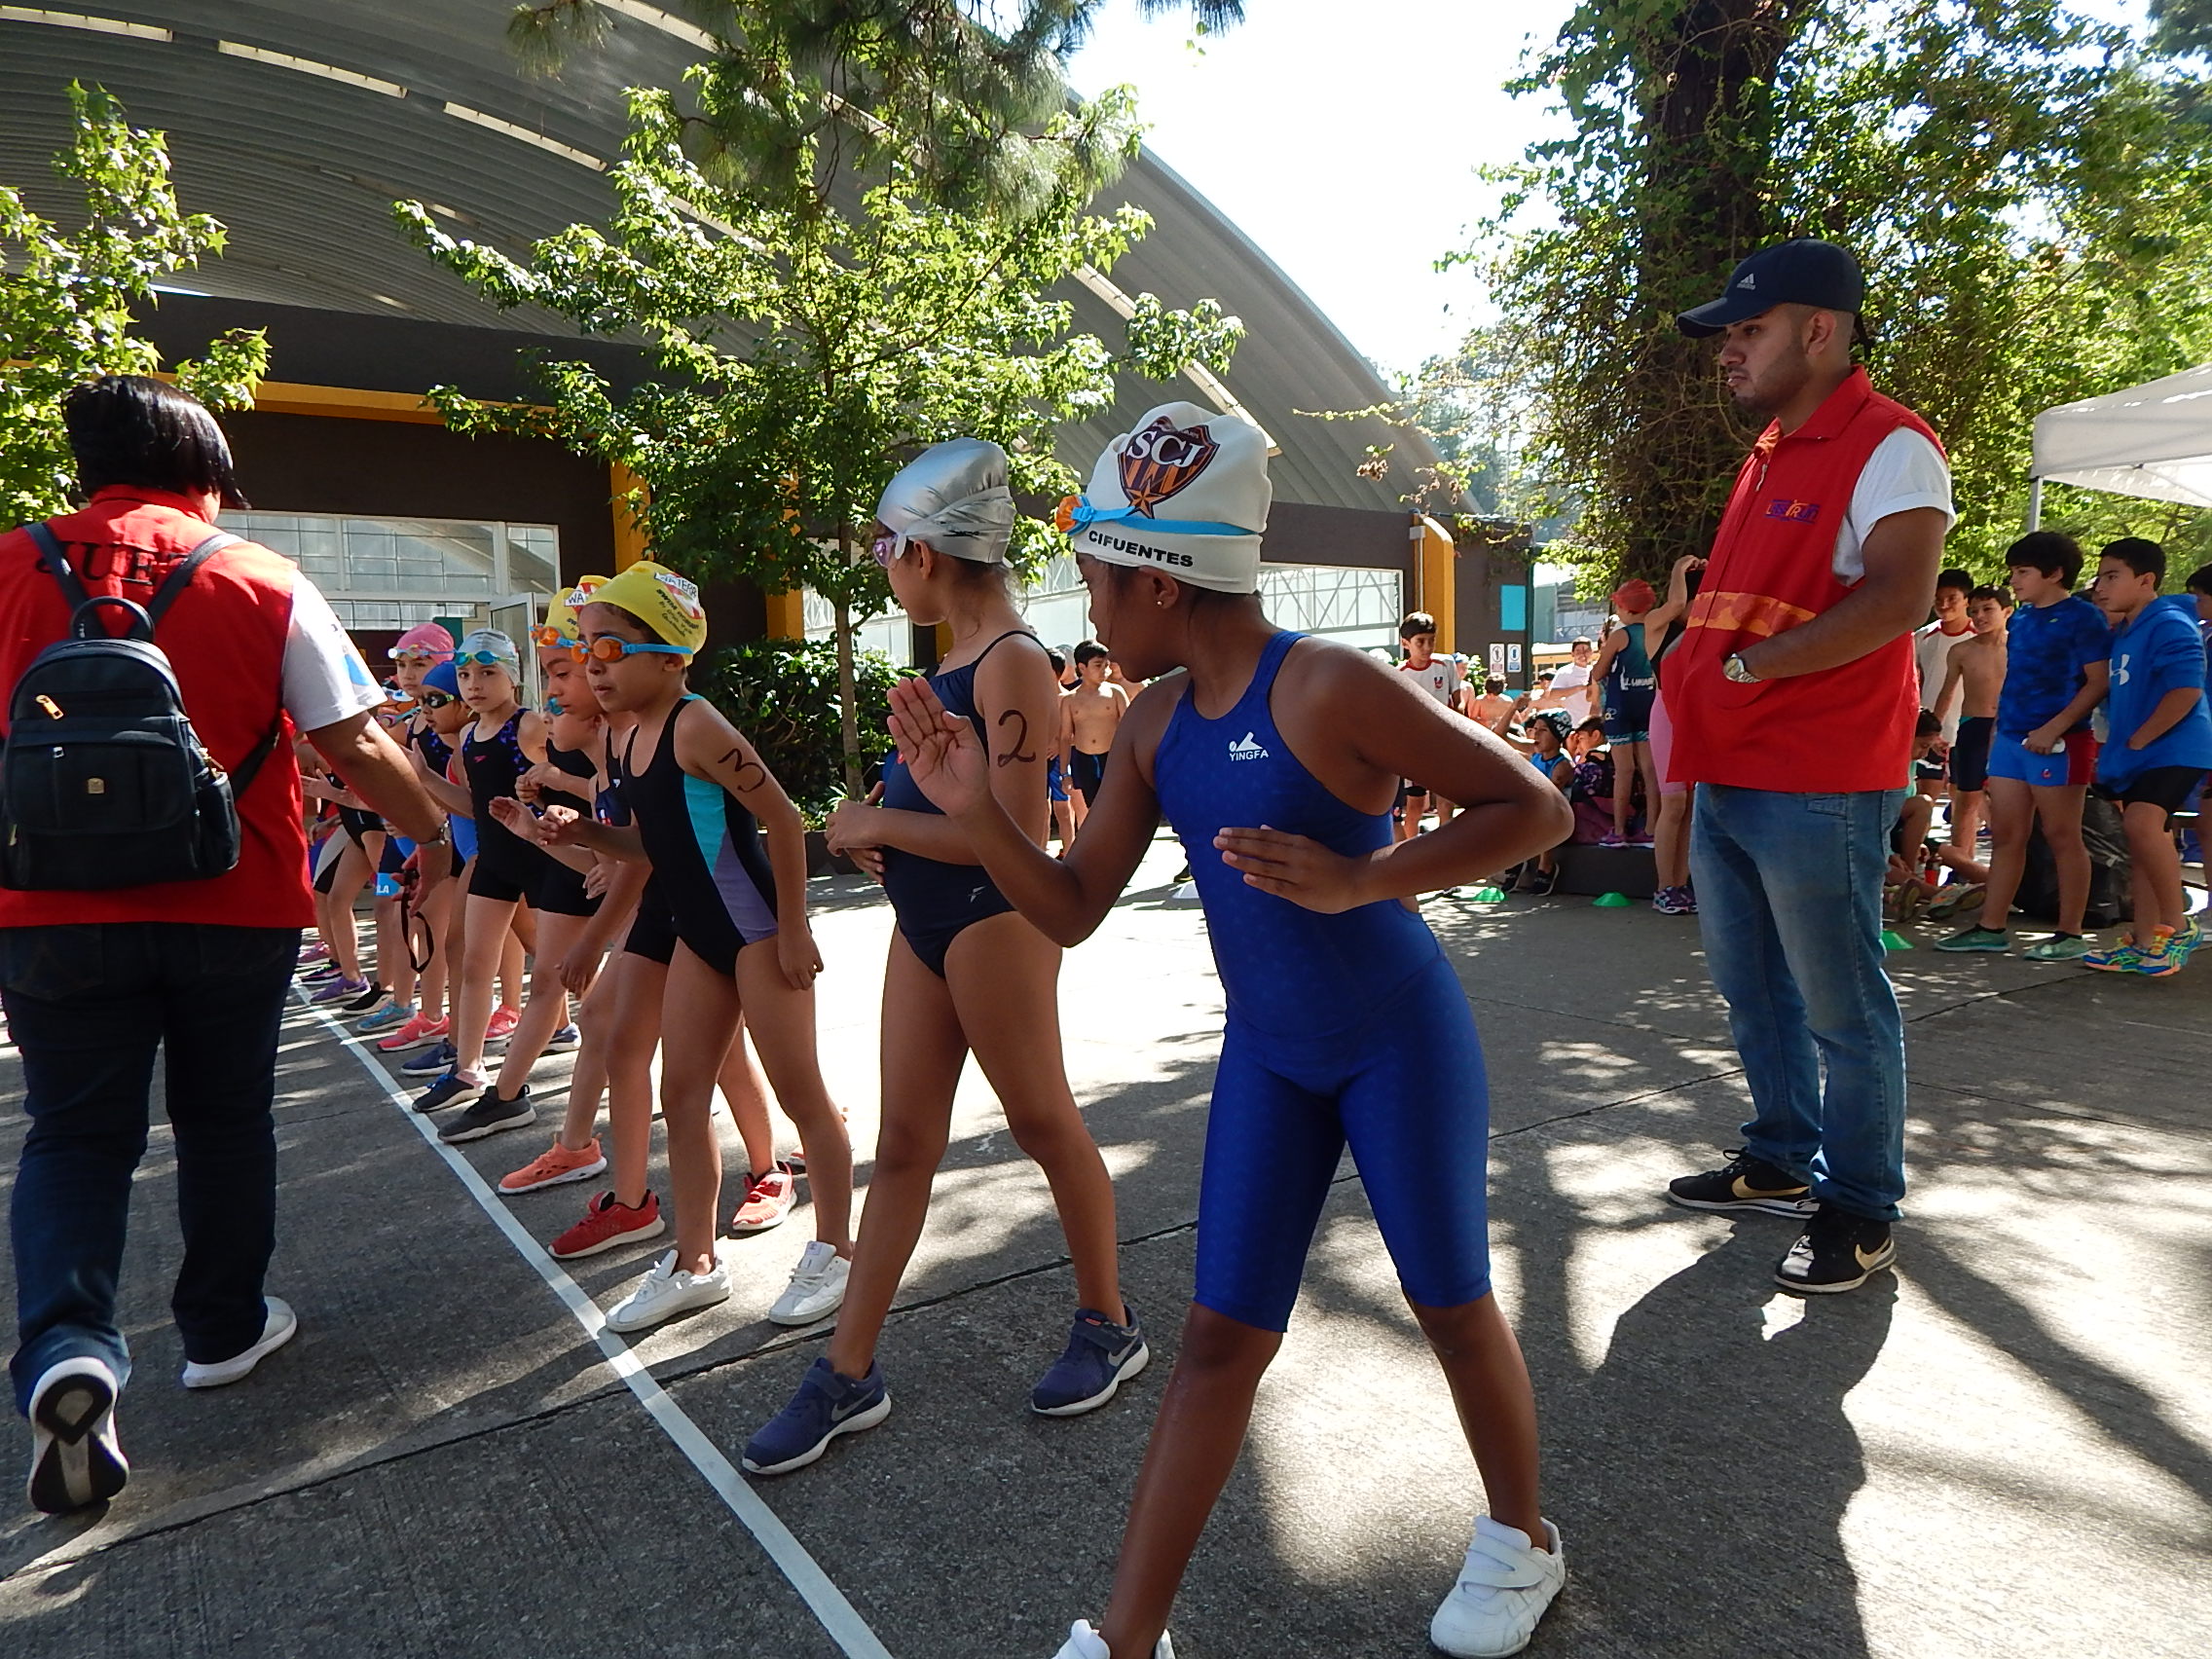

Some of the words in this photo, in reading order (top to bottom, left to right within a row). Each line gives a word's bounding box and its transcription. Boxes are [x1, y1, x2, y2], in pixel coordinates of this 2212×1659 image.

[1088, 530, 1194, 568] CIFUENTES
[998, 709, 1037, 768] 2
[1229, 749, 1270, 762] YINGFA
[718, 748, 766, 793] 3
